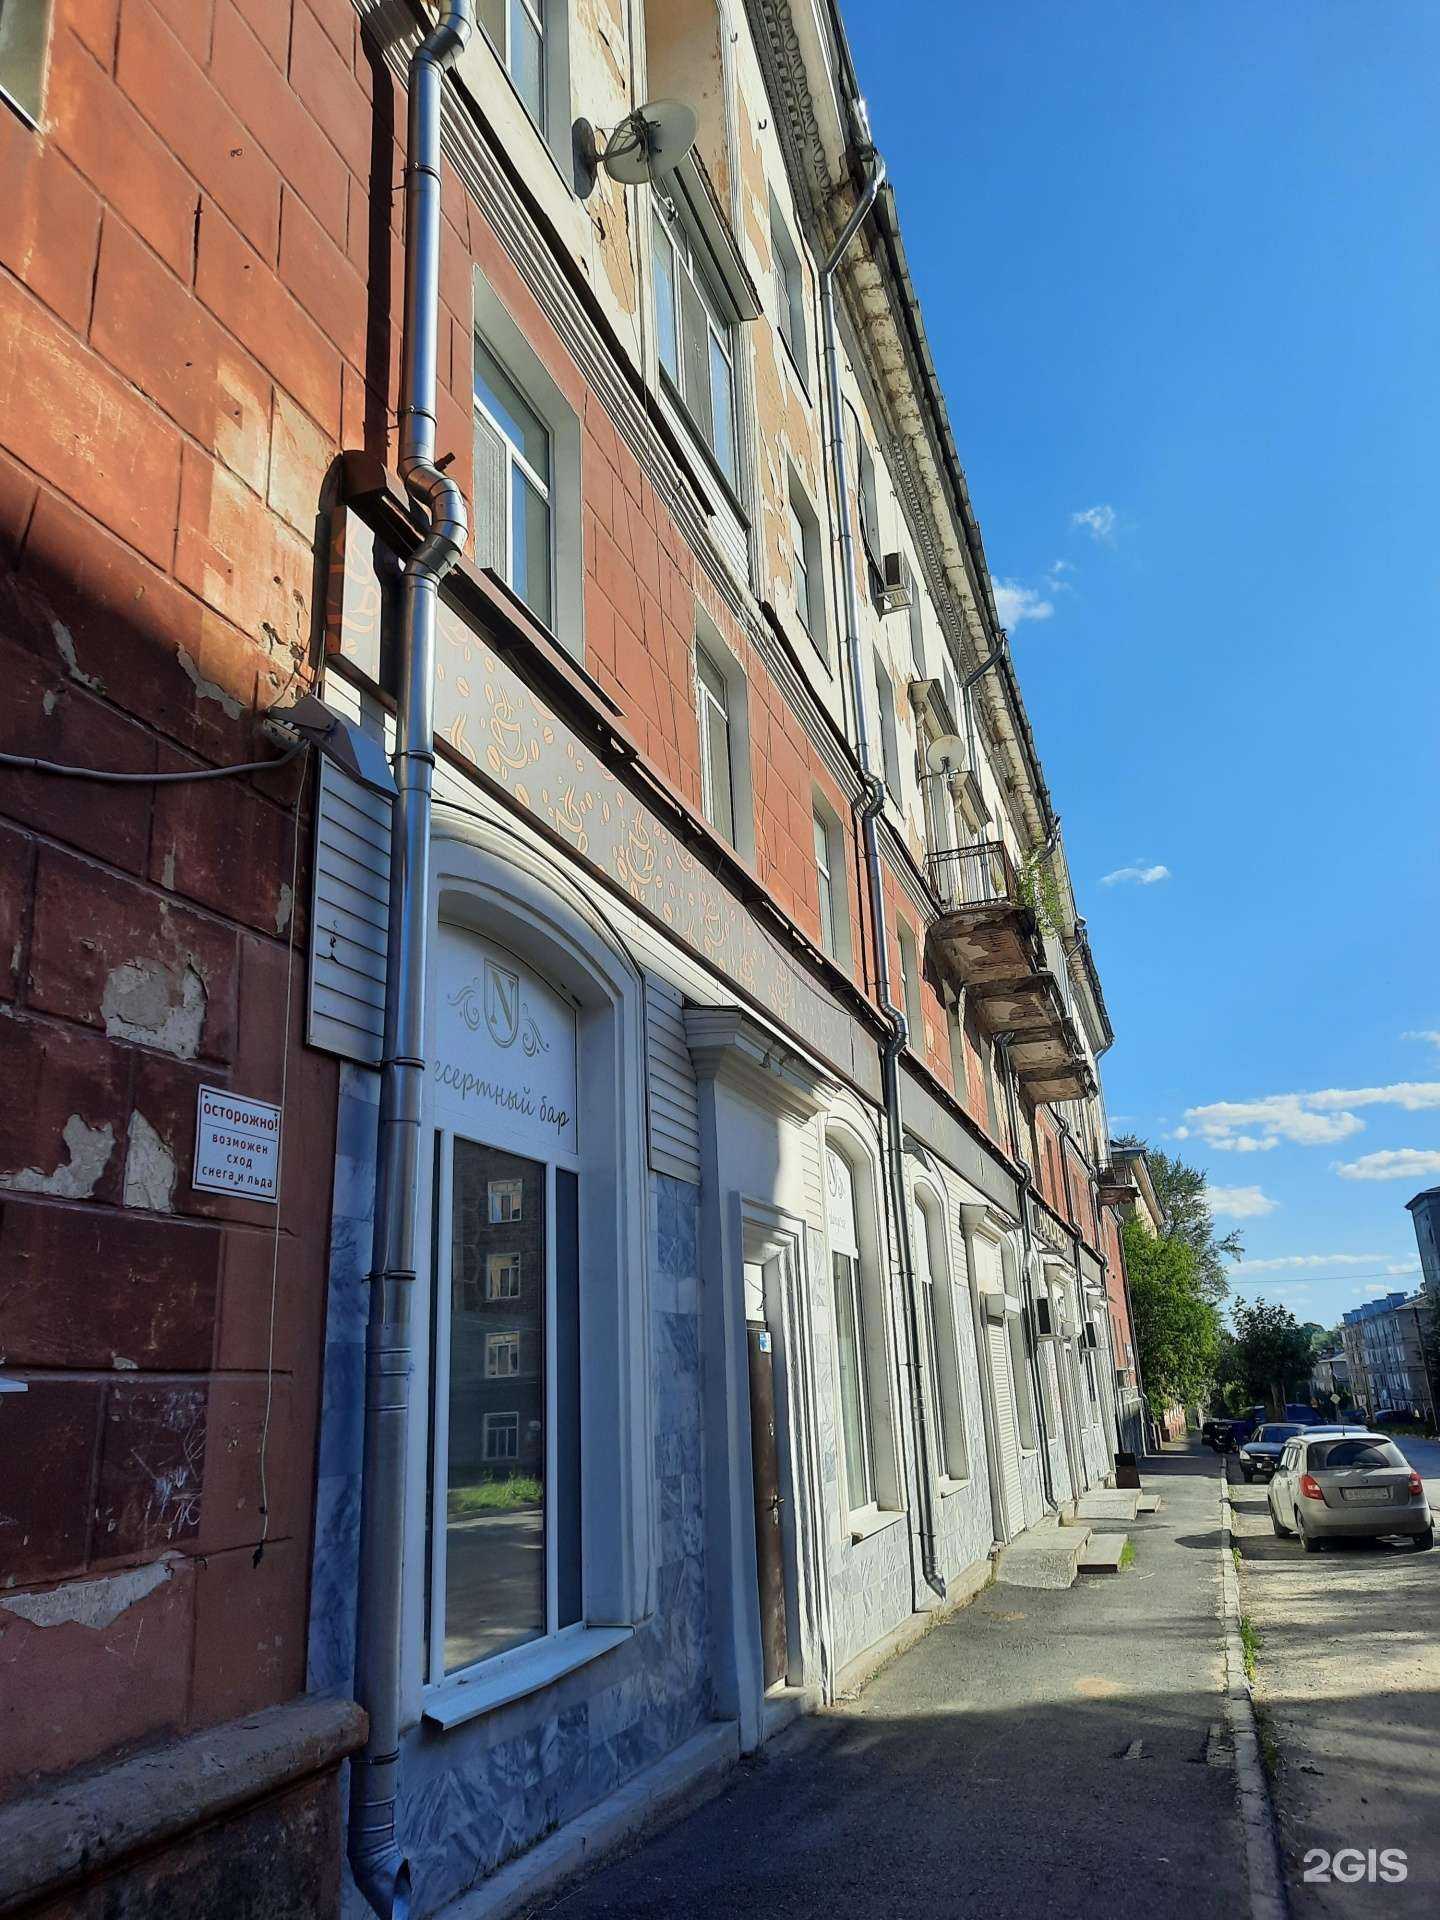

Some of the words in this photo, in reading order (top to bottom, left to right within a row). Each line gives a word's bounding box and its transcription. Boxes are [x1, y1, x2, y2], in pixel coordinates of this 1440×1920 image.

[539, 1096, 570, 1136] бар
[212, 1134, 268, 1154] возможен
[226, 1154, 253, 1169] сход
[202, 1166, 234, 1181] снега
[247, 1175, 273, 1188] льда
